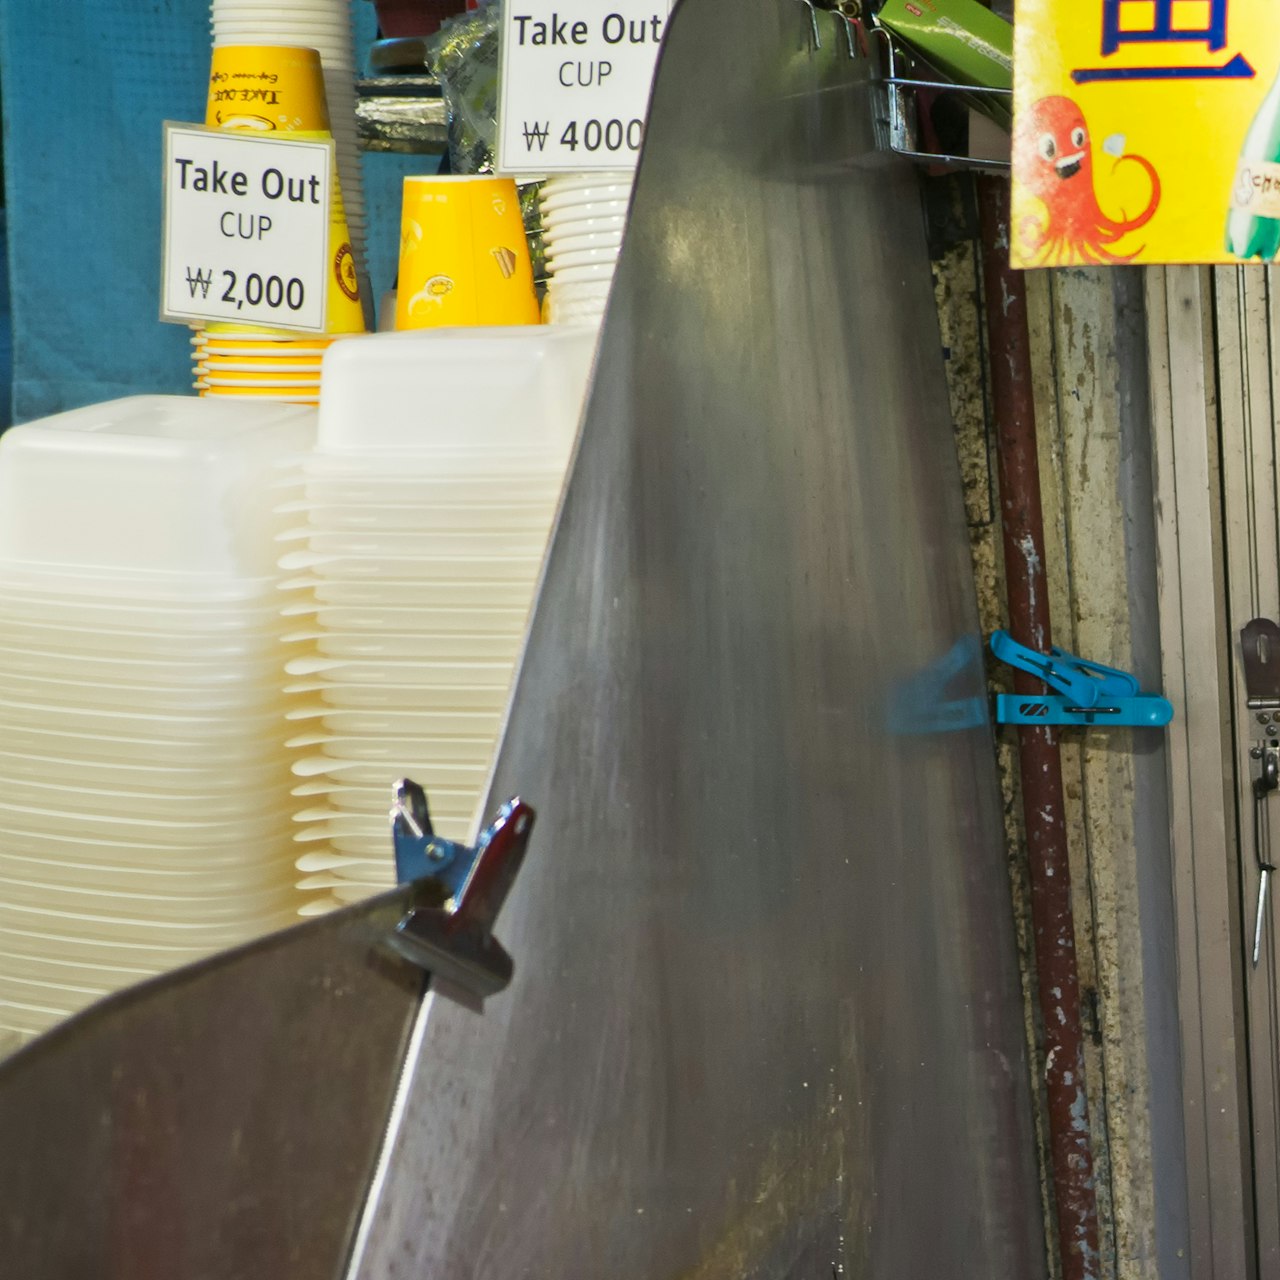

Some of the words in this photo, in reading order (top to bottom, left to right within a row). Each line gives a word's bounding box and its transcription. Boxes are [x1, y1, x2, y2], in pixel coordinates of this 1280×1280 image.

[514, 13, 588, 45] Take
[602, 13, 662, 44] Out
[559, 61, 612, 87] CUP
[560, 119, 645, 151] 4000
[175, 158, 248, 196] Take
[261, 168, 320, 204] Out
[220, 211, 273, 240] CUP
[221, 270, 305, 310] 2,000
